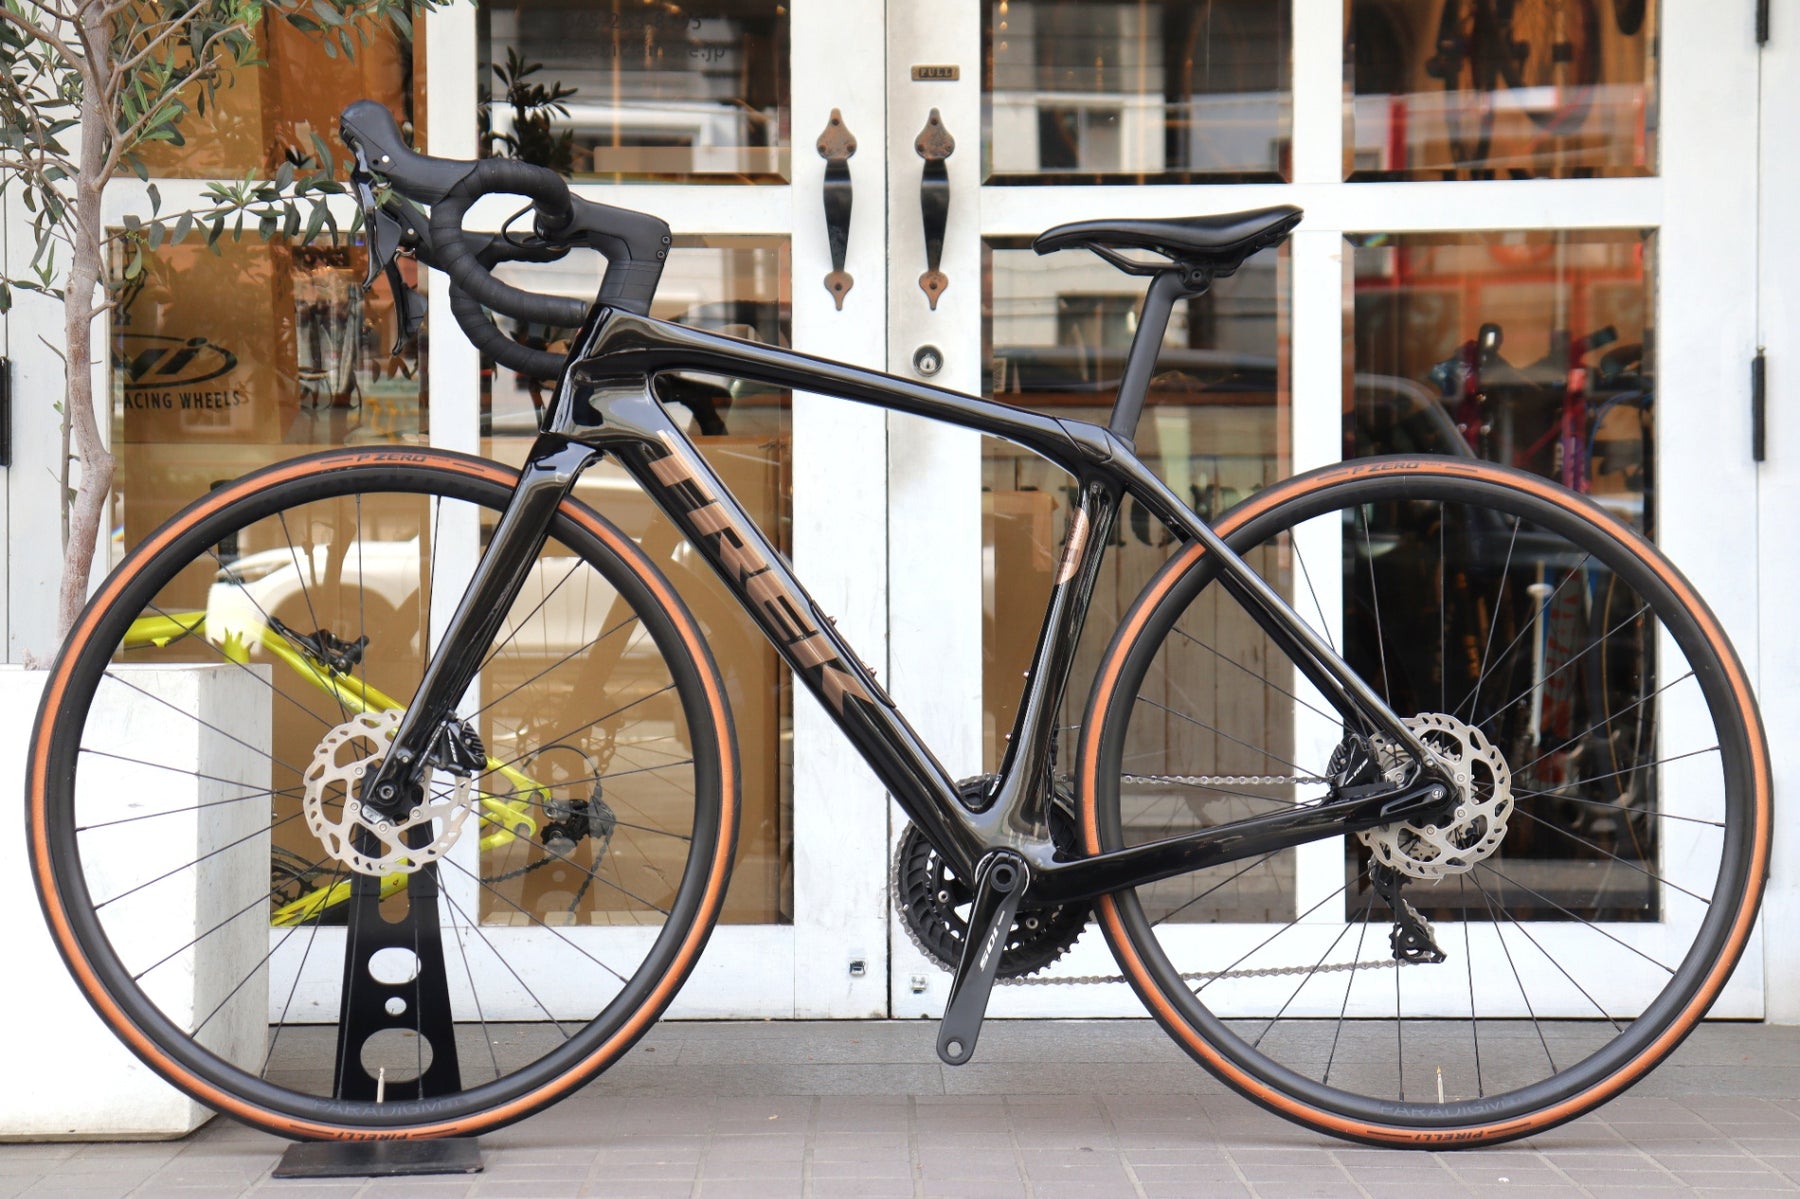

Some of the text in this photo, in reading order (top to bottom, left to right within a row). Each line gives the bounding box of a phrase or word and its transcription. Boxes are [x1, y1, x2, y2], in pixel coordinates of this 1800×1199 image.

[919, 67, 953, 78] PULL
[179, 390, 241, 409] WHEELS
[373, 453, 427, 463] ZERO
[1368, 462, 1420, 473] ZERO
[648, 430, 873, 717] TREK
[337, 1130, 409, 1142] PIRELLI
[1415, 1129, 1485, 1142] PIRELLI
